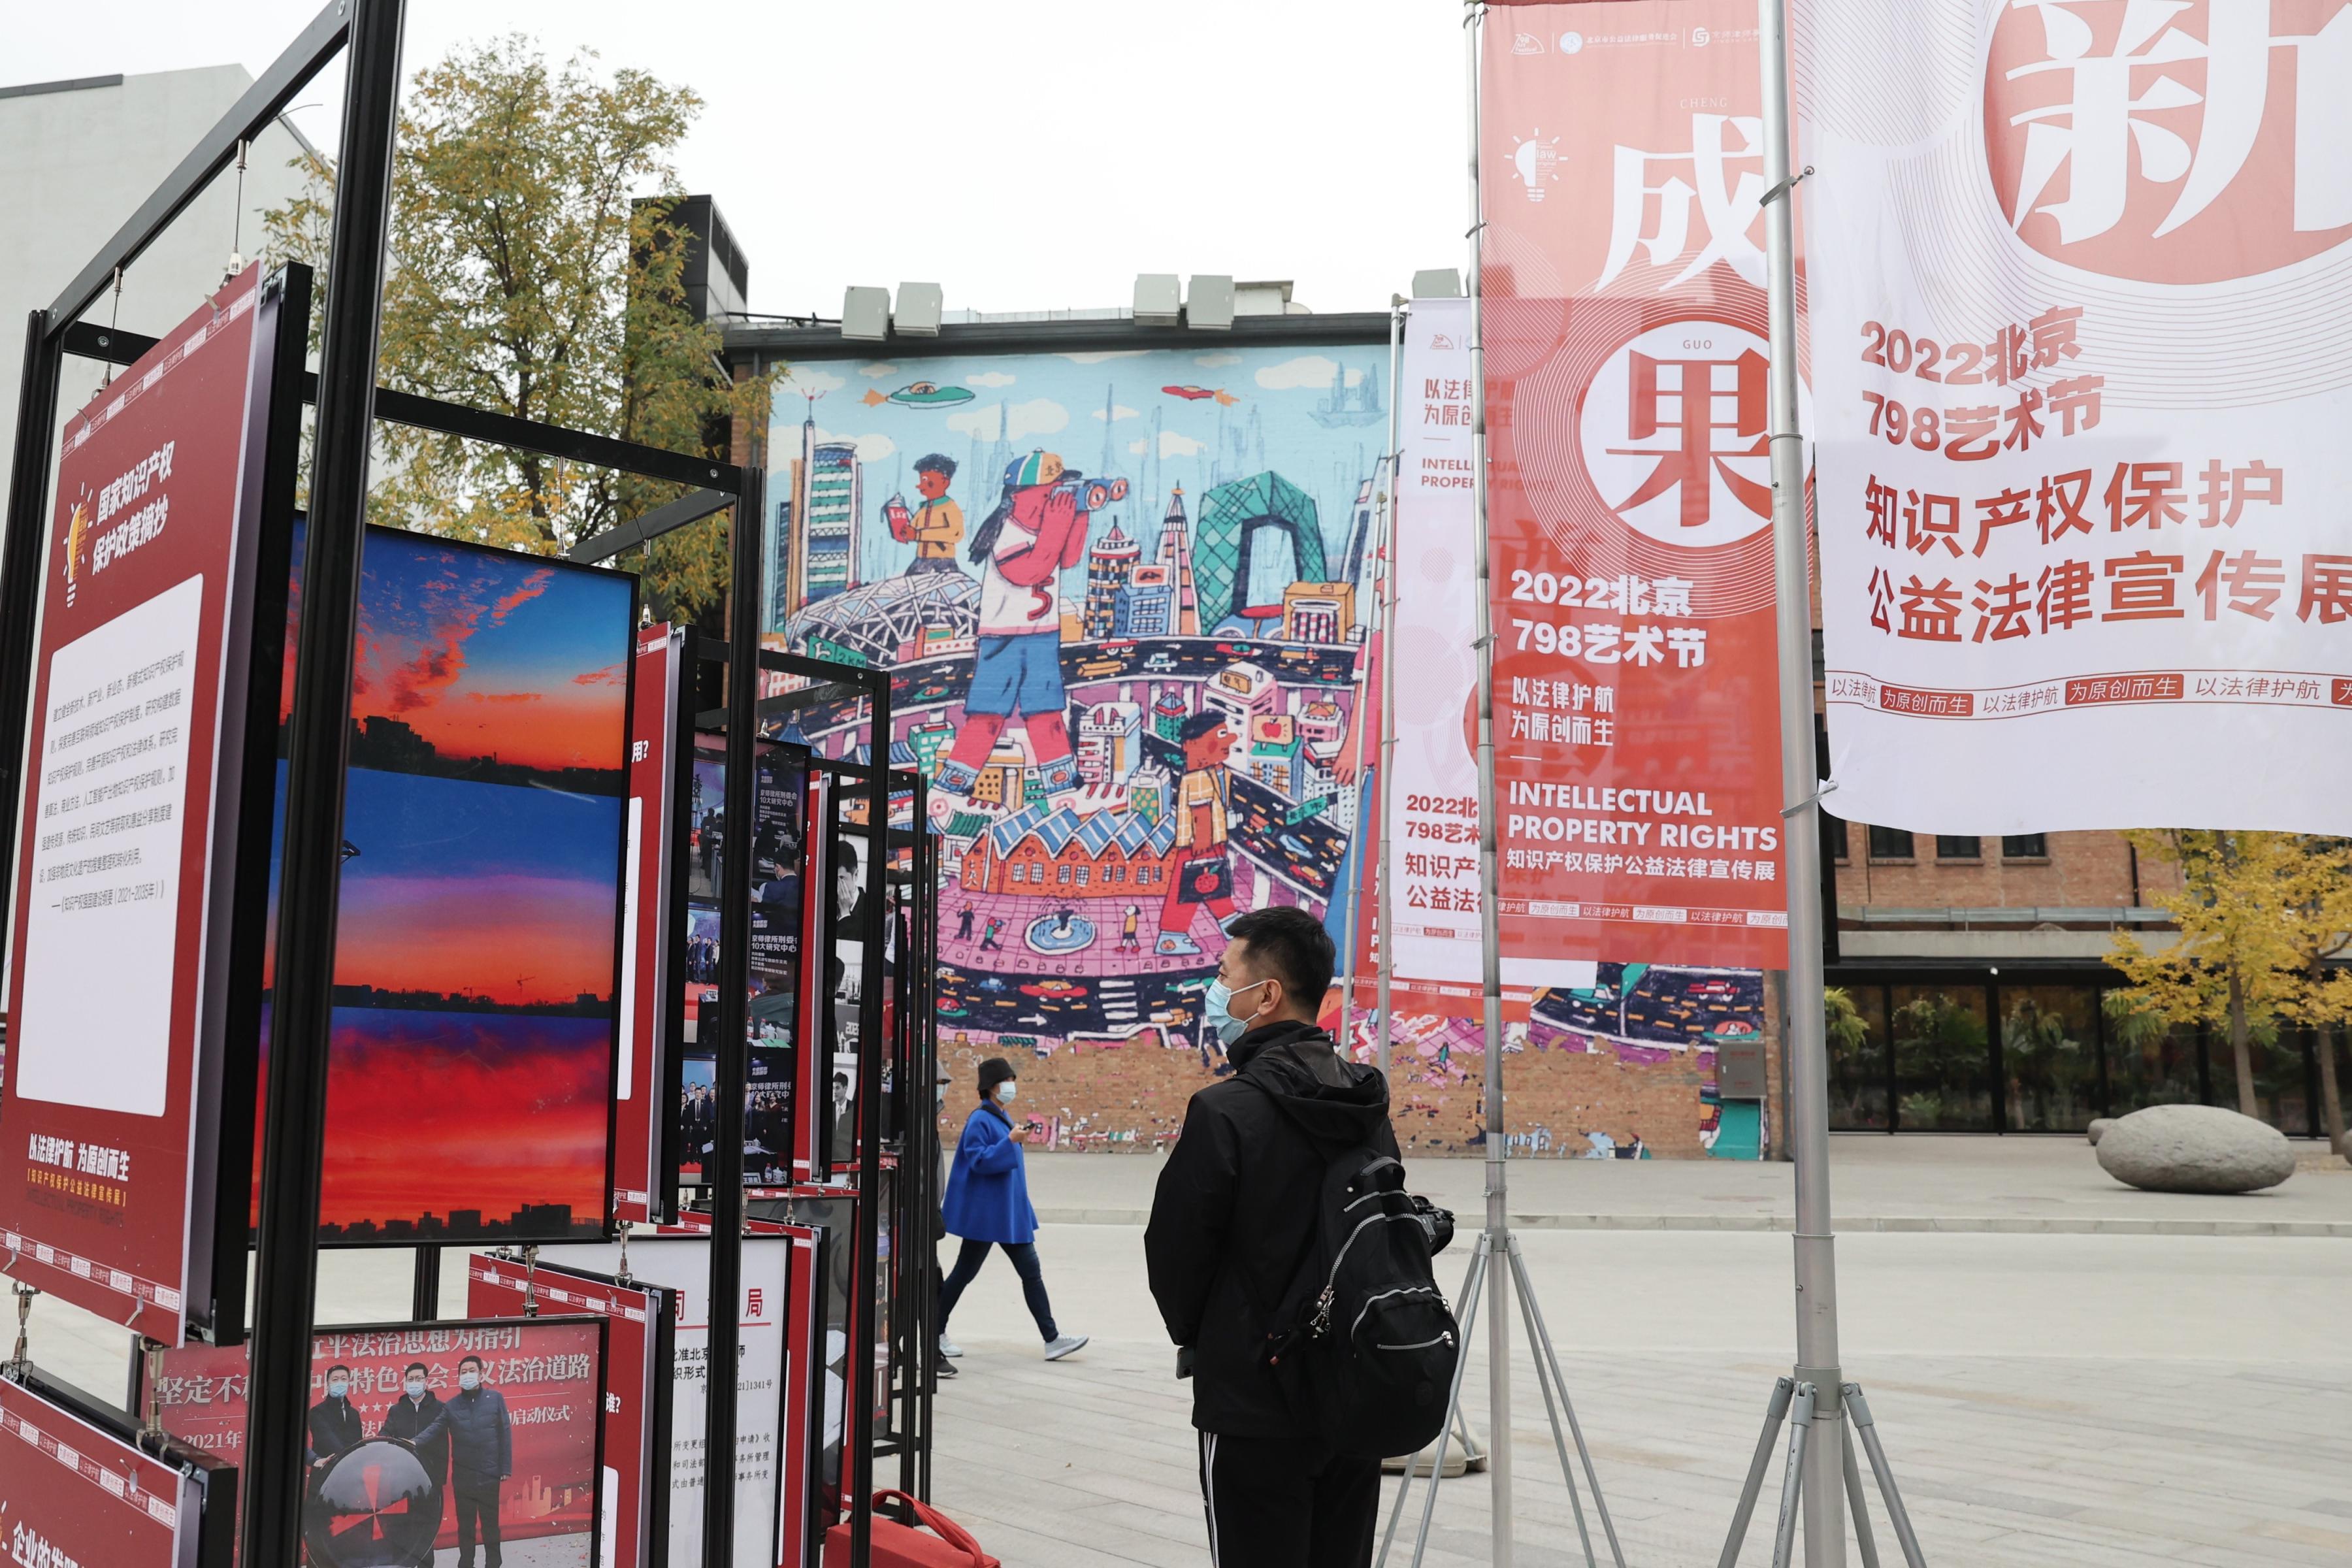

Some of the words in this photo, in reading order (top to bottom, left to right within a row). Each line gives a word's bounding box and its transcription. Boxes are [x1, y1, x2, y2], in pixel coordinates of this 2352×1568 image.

[1680, 97, 1727, 110] CHENG
[1536, 148, 1557, 159] law
[1682, 339, 1712, 350] GUO
[1861, 305, 2083, 387] 2022北京
[1862, 374, 2105, 461] 798艺术节
[1605, 346, 1772, 527] 果
[97, 440, 175, 527] 国家知识产权
[1864, 459, 2284, 559] 知识产权保护
[91, 493, 169, 576] 保护政策摘抄
[1511, 569, 1693, 617] 2022北京
[1867, 549, 2352, 644] 公益法律宣传展
[1512, 618, 1707, 668] 798艺术节
[1512, 676, 1614, 713] 以法律护航
[1884, 689, 1968, 715] 为原创而生
[1982, 685, 2060, 713] 以法律护航
[2068, 676, 2178, 702] 为原创而生
[2195, 676, 2321, 701] 以法律护航
[1511, 710, 1614, 747] 为原创而生
[1509, 781, 1712, 816] INTELLECTUAL
[1508, 814, 1652, 846] PROPERTY
[1660, 823, 1778, 851] RIGHTS
[1405, 852, 1482, 879] 知识产
[1507, 847, 1776, 882] 知识产权保护公益法律宣传展
[1407, 885, 1482, 914] 公益法
[1530, 903, 1578, 917] 为原创而生
[1582, 906, 1630, 919] 以法律护航
[1635, 907, 1685, 922] 为原创而生
[1691, 911, 1744, 924] 以法律护航
[751, 941, 797, 953] 10大研究中心
[28, 1132, 74, 1170] 以法律护航
[76, 1142, 131, 1182] 为原创而生
[745, 1288, 763, 1318] 局
[735, 1450, 770, 1464] 务所管理
